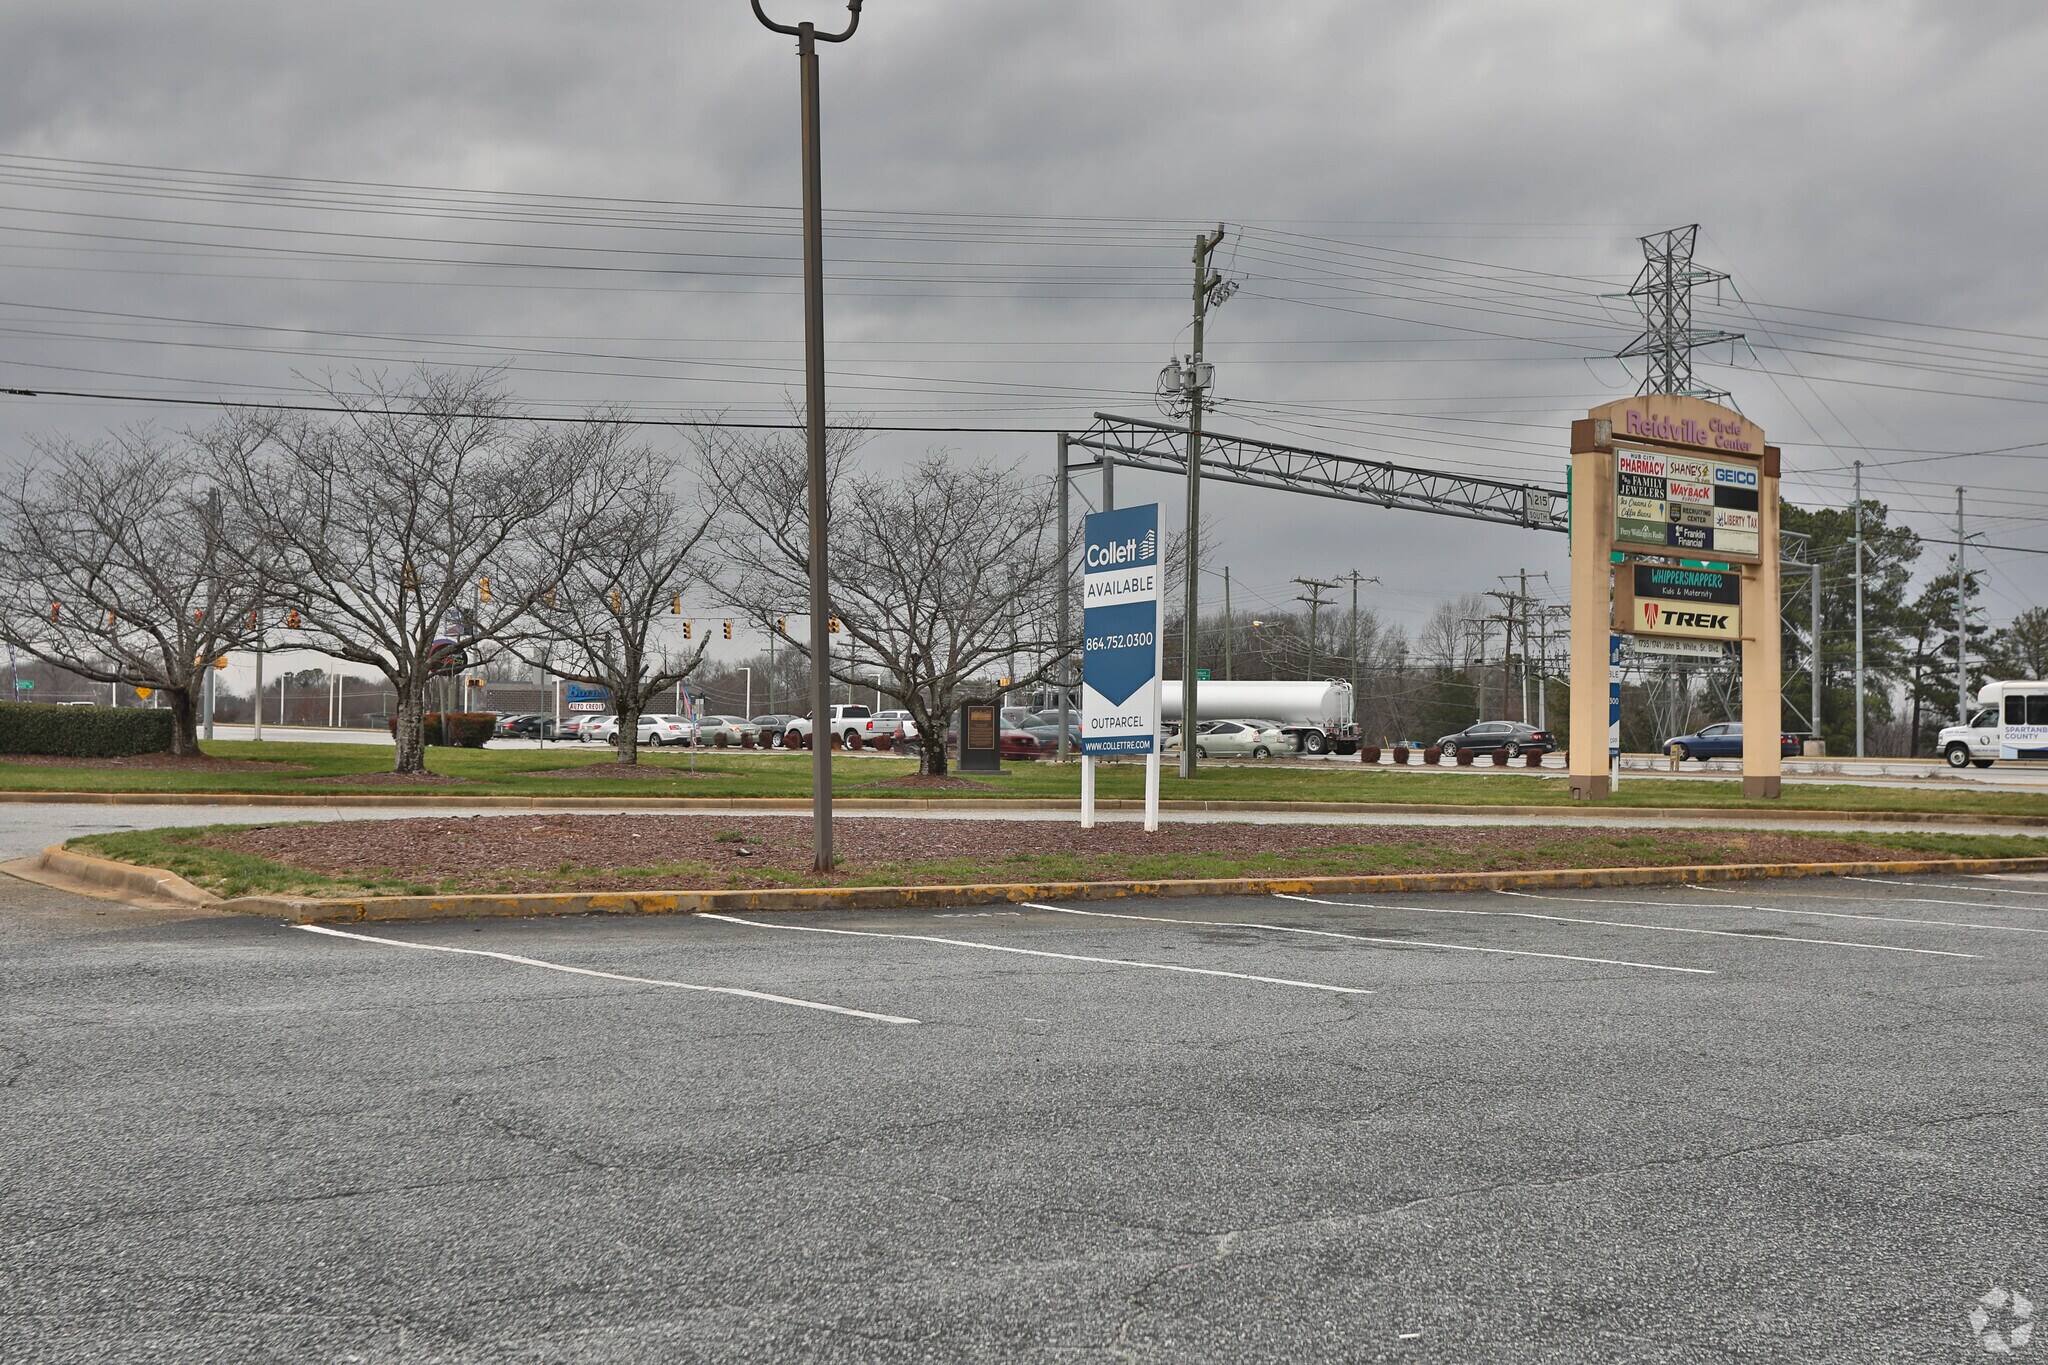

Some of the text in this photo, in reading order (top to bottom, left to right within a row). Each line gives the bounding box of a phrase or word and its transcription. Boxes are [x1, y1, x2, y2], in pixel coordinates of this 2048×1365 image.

[1626, 409, 1741, 445] Reidville Circle
[1715, 434, 1752, 452] Center
[1620, 457, 1665, 476] PHARMACY
[1670, 461, 1702, 478] SHANE'S
[1632, 475, 1663, 489] FAMILY
[1715, 468, 1757, 486] GEICO
[1620, 484, 1665, 498] JEWELERS
[1670, 482, 1711, 499] WAYBACK
[1534, 494, 1548, 507] 215
[1529, 511, 1548, 521] SOUTH
[1682, 507, 1711, 517] RECRUITING
[1687, 515, 1706, 523] CENTER
[1723, 512, 1758, 529] LIBERTY TAX
[1683, 528, 1706, 540] Franklin
[1678, 536, 1703, 548] Financial
[1087, 538, 1137, 567] Collett
[1651, 568, 1723, 589] WHIPPERSNAPPERS
[1087, 575, 1154, 599] AVAILABLE
[1662, 587, 1713, 600] Kids & Maternity
[1661, 610, 1730, 630] TREK
[1086, 631, 1153, 652] 864.752.0300
[1662, 641, 1675, 650] John
[1091, 716, 1144, 730] OUTPARCEL
[1085, 741, 1151, 751] WWW.COLLETTRE.COM
